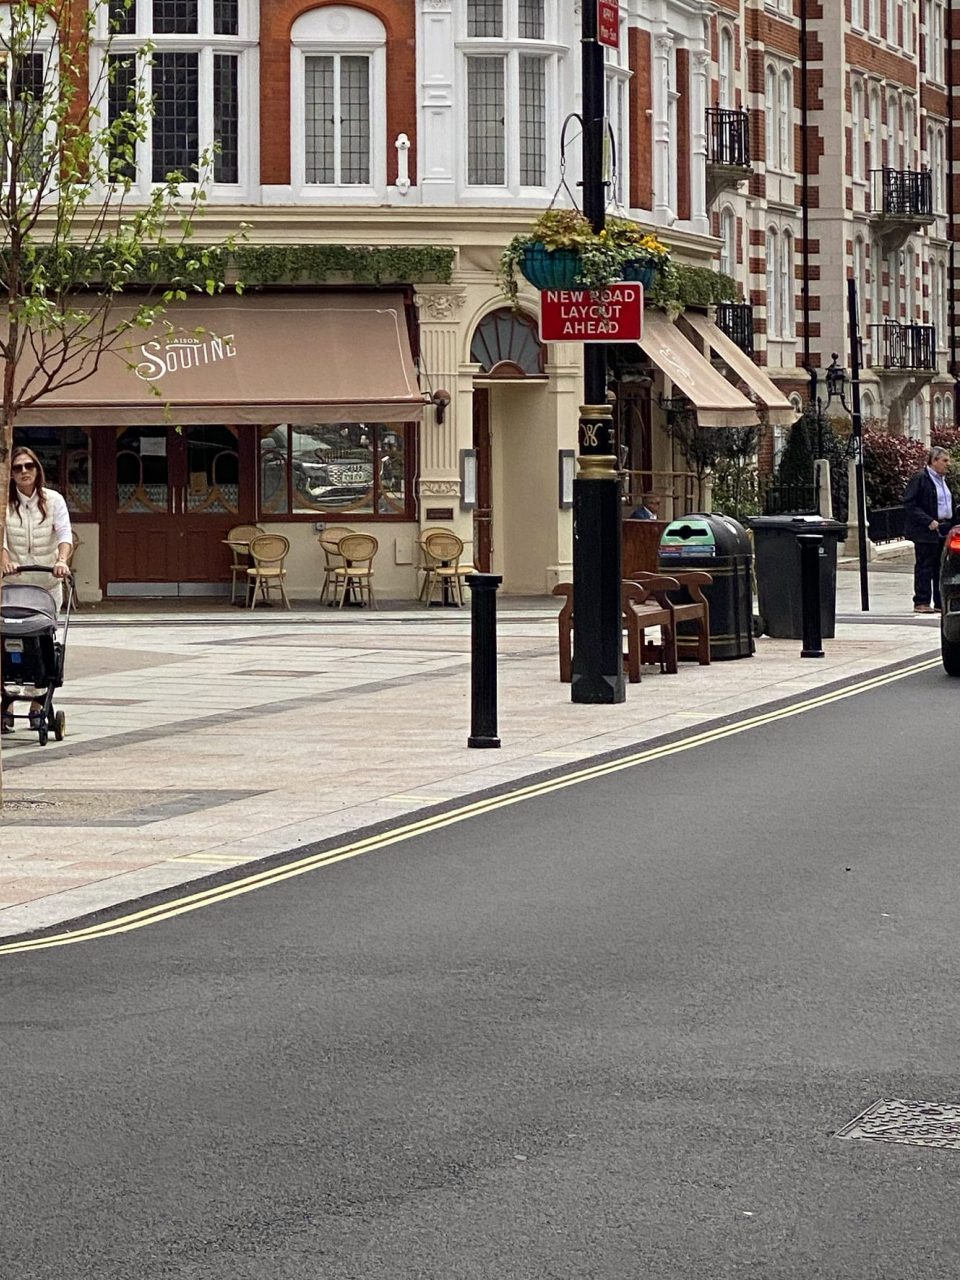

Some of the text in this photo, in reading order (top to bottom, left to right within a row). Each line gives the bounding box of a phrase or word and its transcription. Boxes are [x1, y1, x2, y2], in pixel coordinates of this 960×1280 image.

[547, 290, 584, 303] NEW
[561, 306, 622, 319] LAYOUT
[563, 321, 619, 335] AHEAD
